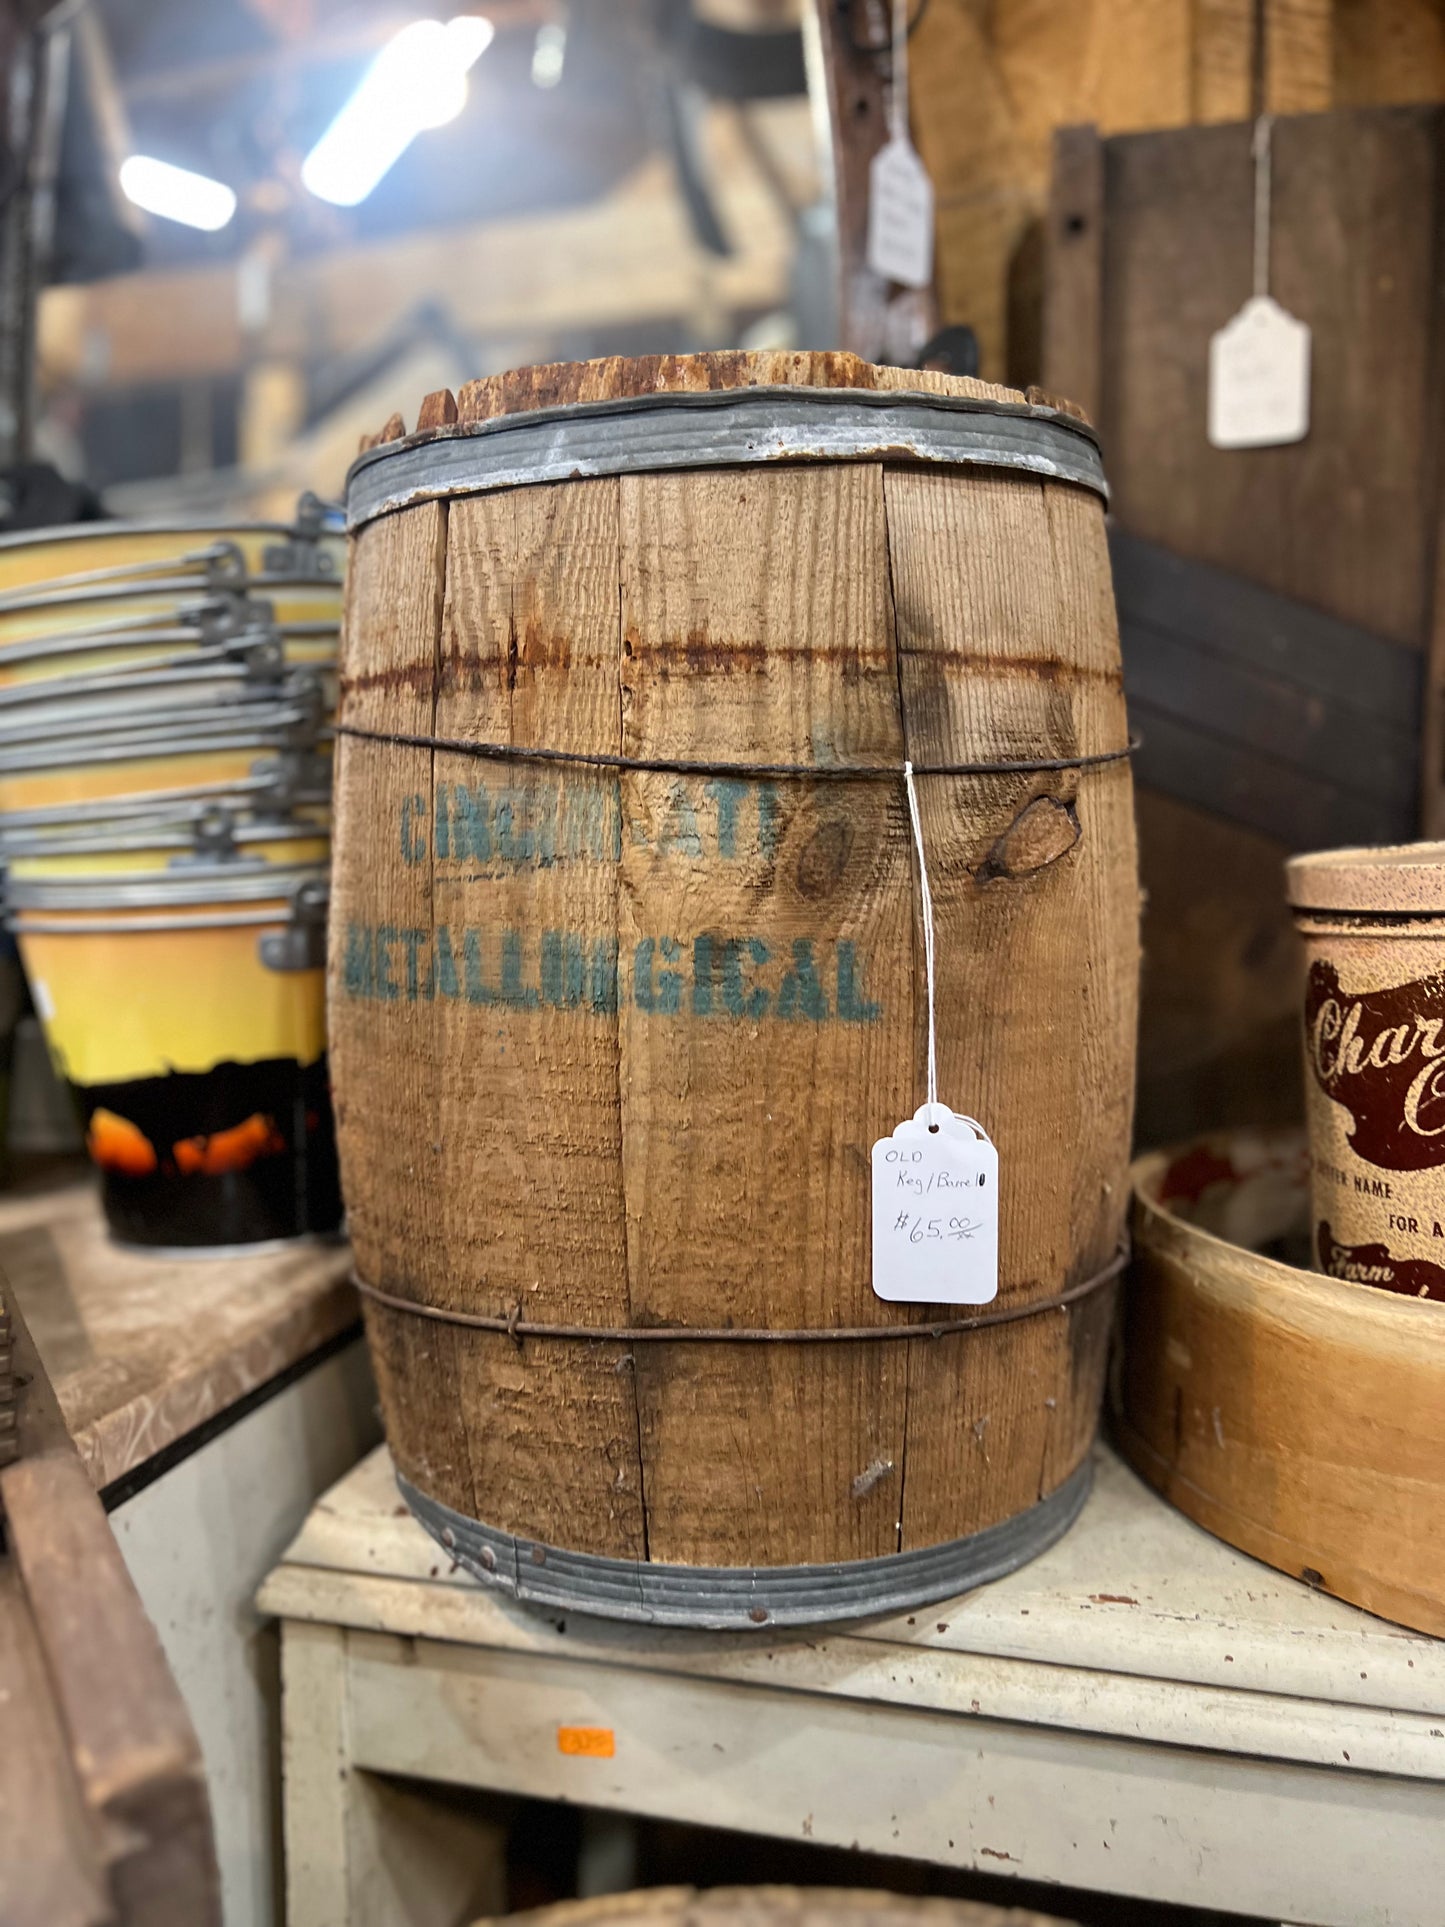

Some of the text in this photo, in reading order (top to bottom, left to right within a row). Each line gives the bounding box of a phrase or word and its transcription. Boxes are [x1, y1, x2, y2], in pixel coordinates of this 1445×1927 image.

[885, 1150, 923, 1163] OLD
[1354, 1175, 1393, 1200] NAME
[1389, 1214, 1419, 1234] FOR
